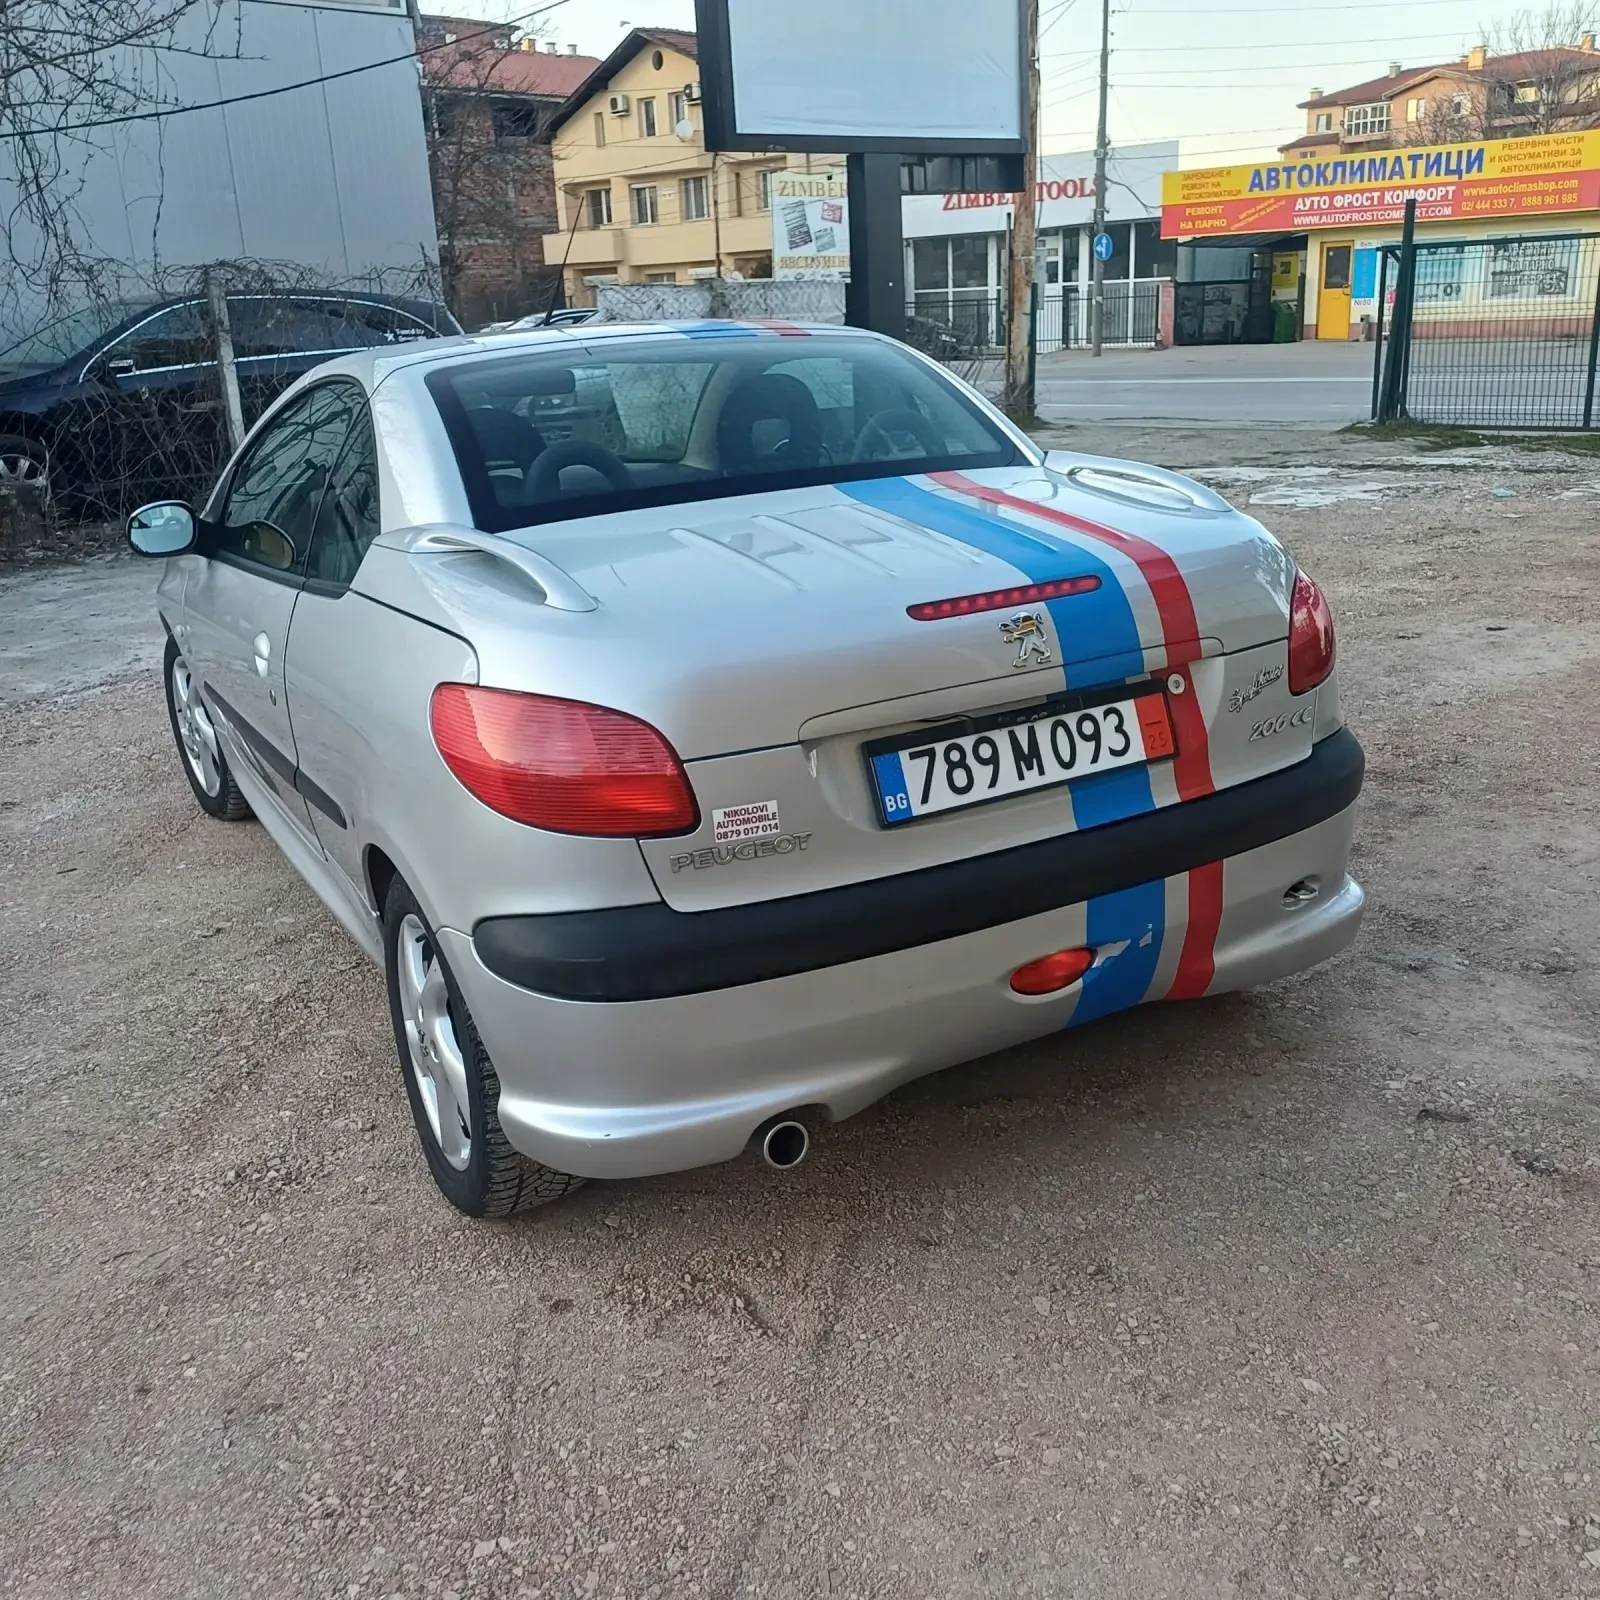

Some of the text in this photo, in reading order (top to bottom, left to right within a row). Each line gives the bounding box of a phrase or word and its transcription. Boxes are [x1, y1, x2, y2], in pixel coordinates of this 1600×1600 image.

[1502, 136, 1585, 151] РЕЗЕРВНИ ЧАСТИ
[1498, 149, 1567, 162] КОНСУМАТИВИ
[1569, 147, 1582, 156] ЗА
[1248, 148, 1485, 193] АВТОКЛИМАТИЦИ
[1500, 159, 1582, 174] АВТОКЛИМАТИЦИ
[1463, 180, 1578, 196] www.autoclimashop.com
[1295, 185, 1456, 211] АУТО ФРОСТ КОМФОРТ
[1476, 200, 1491, 210] 444
[1492, 199, 1508, 209] 333
[1521, 196, 1542, 207] 0888
[1544, 195, 1559, 205] 961
[1561, 193, 1578, 204] 985
[1185, 205, 1225, 217] РЕМОНТ
[1293, 206, 1452, 225] WWW.AUTOFROSTCOMFRT.COM
[1180, 219, 1227, 230] НА ПАРНО
[1249, 706, 1313, 742] 206 CC
[885, 792, 908, 813] BG
[908, 736, 1000, 805] 789
[1007, 725, 1045, 781] M
[1050, 706, 1131, 771] 093
[723, 804, 768, 819] NIKOLOVI
[716, 812, 778, 830] AUTOMOBILE
[716, 823, 779, 841] 0879 017 014
[669, 830, 813, 873] PEUGEOT
